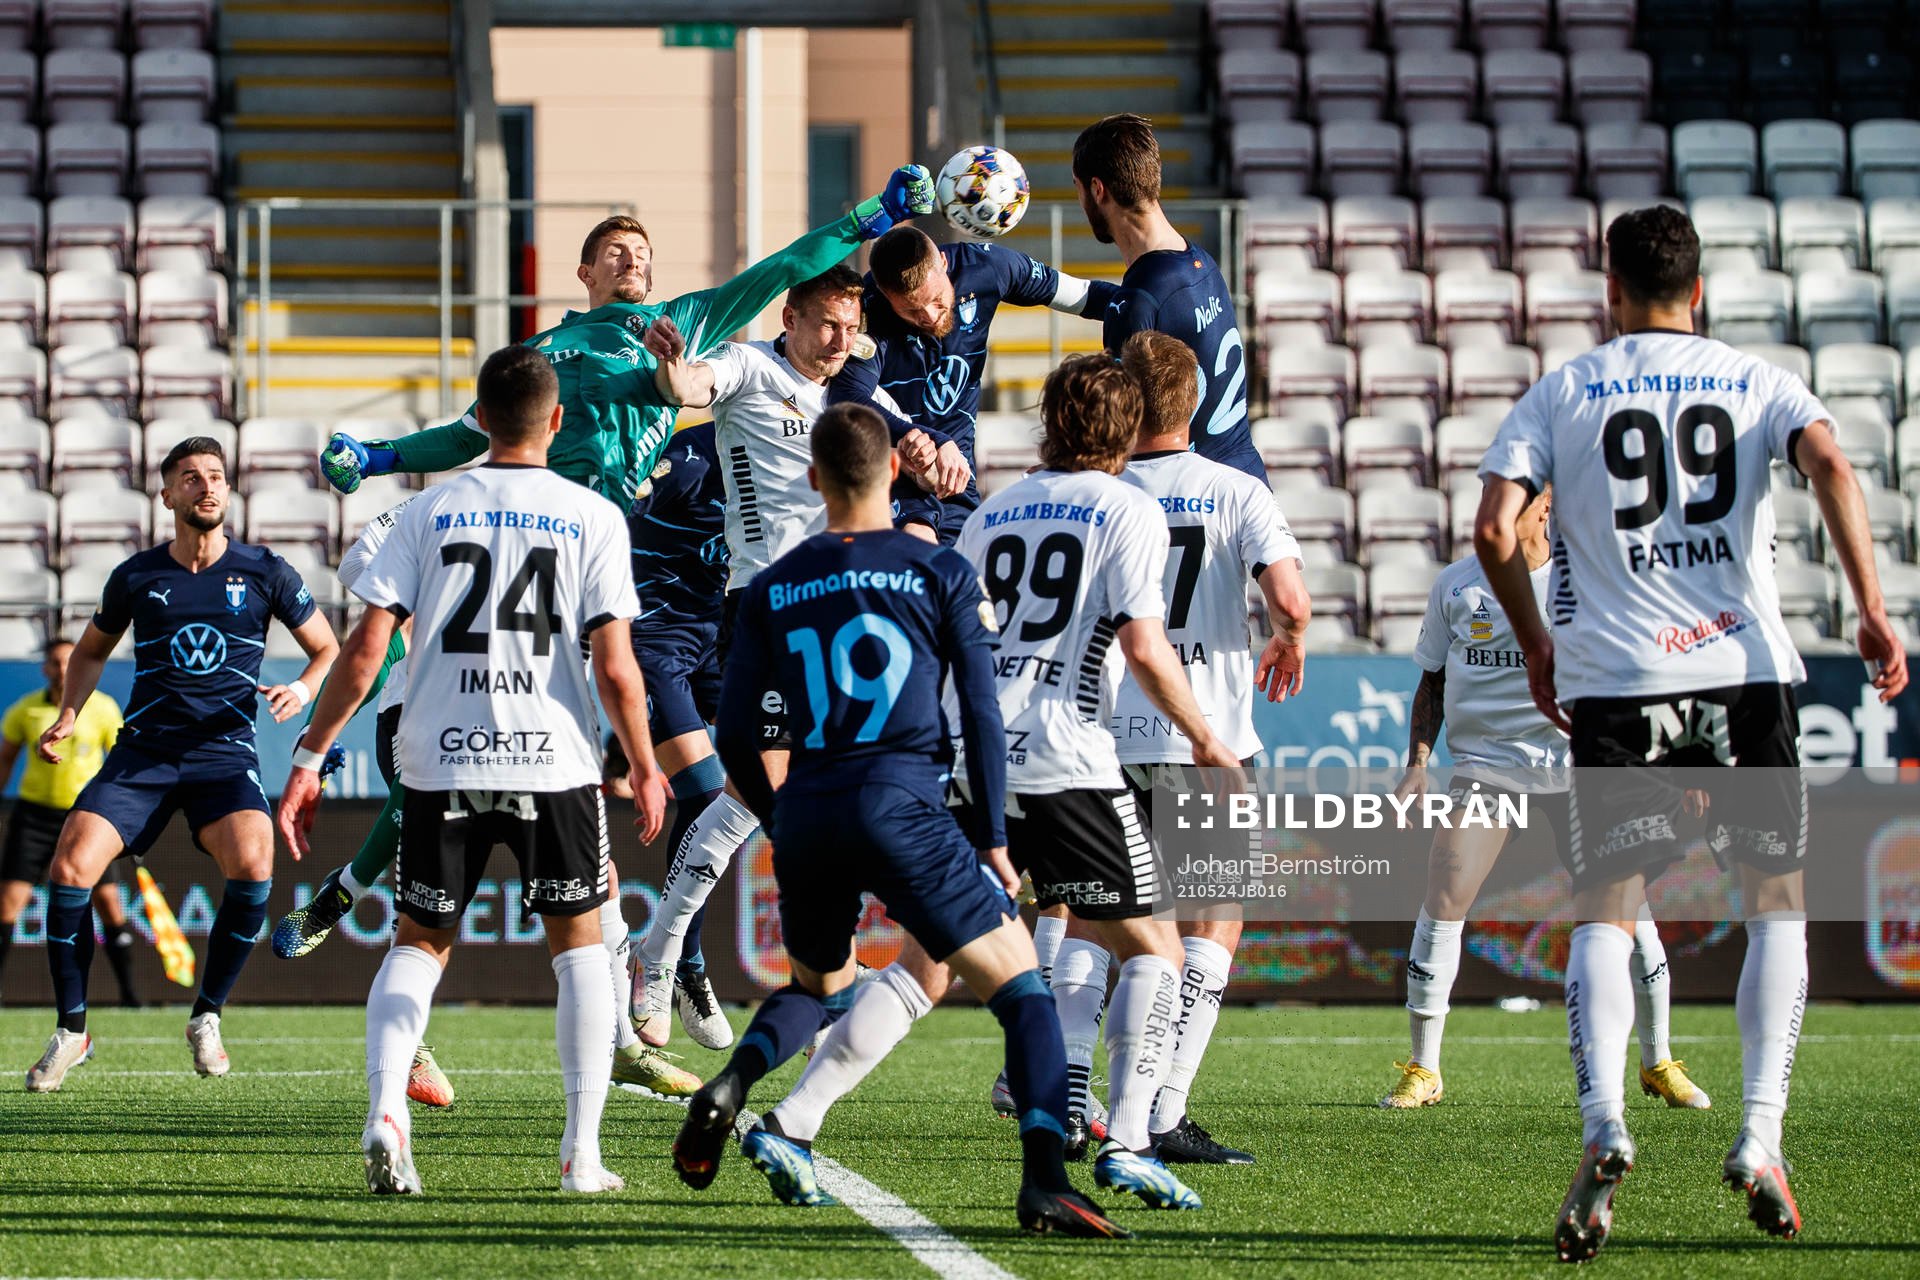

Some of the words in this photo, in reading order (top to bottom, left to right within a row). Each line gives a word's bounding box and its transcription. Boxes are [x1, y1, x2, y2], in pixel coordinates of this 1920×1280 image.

[1194, 295, 1223, 334] Nalic
[1586, 374, 1748, 400] MALMBERGS
[1602, 403, 1738, 531] 99
[434, 511, 581, 540] MALMBERGS
[983, 502, 1106, 530] MALMBERGS
[1629, 535, 1735, 573] FATMA
[440, 541, 562, 657] 24
[768, 569, 925, 612] Birmancevic
[985, 532, 1084, 642] 89
[460, 669, 533, 695] IMAN
[785, 612, 913, 749] 19
[440, 725, 553, 753] GÖRTZ
[763, 725, 779, 738] 27
[440, 755, 531, 766] FASTIGHETER
[535, 755, 555, 765] AB
[1605, 814, 1668, 841] NORDIC
[404, 888, 455, 913] WELLNESS
[411, 879, 446, 900] NORDIC
[1043, 880, 1104, 896] NORDIC
